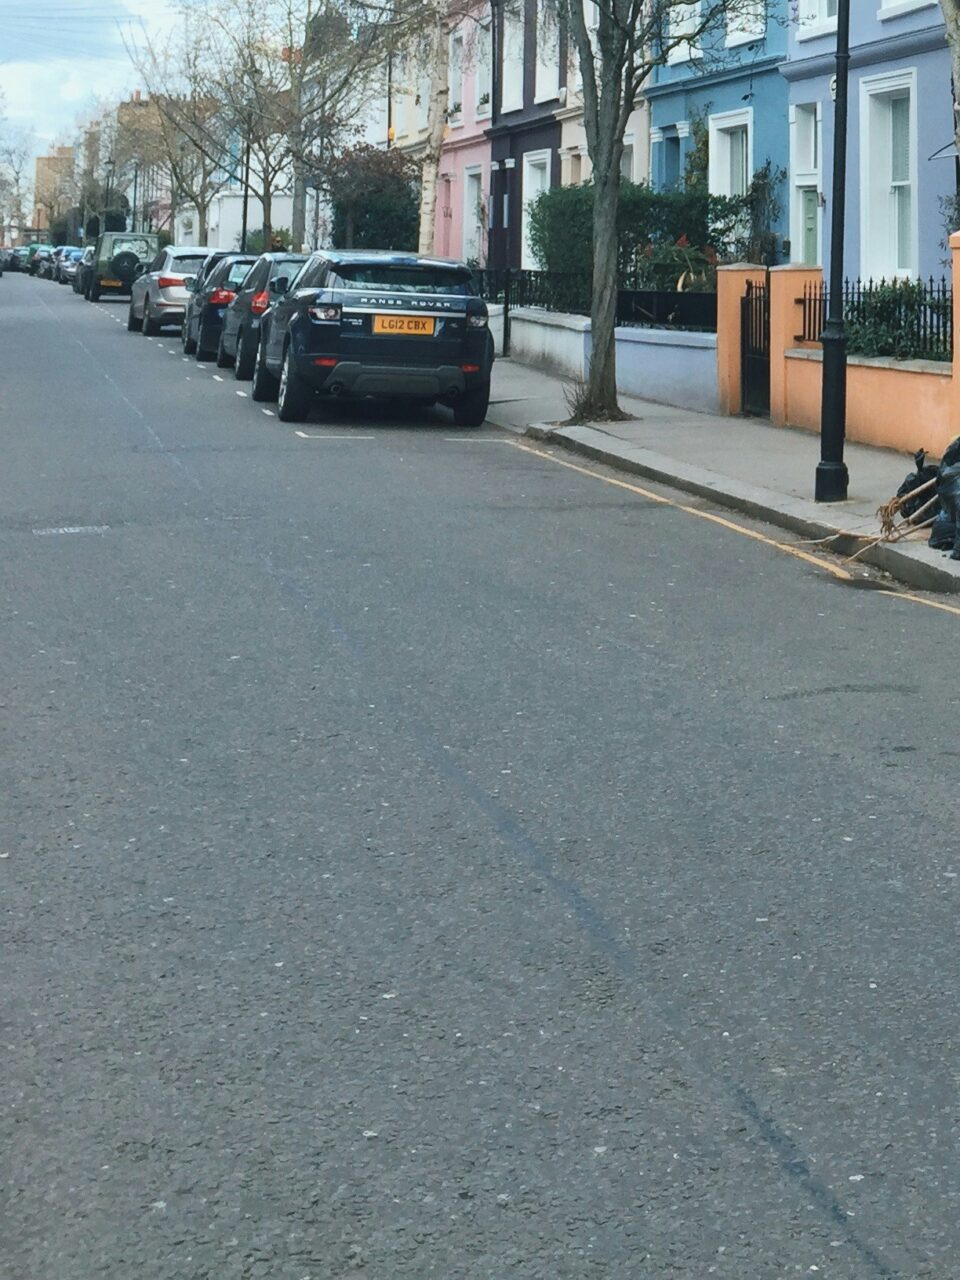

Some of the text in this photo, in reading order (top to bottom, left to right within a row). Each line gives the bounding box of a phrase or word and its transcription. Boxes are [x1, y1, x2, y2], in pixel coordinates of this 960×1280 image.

[360, 297, 451, 308] RANGE ROVER
[381, 319, 427, 331] LG12 CBX
